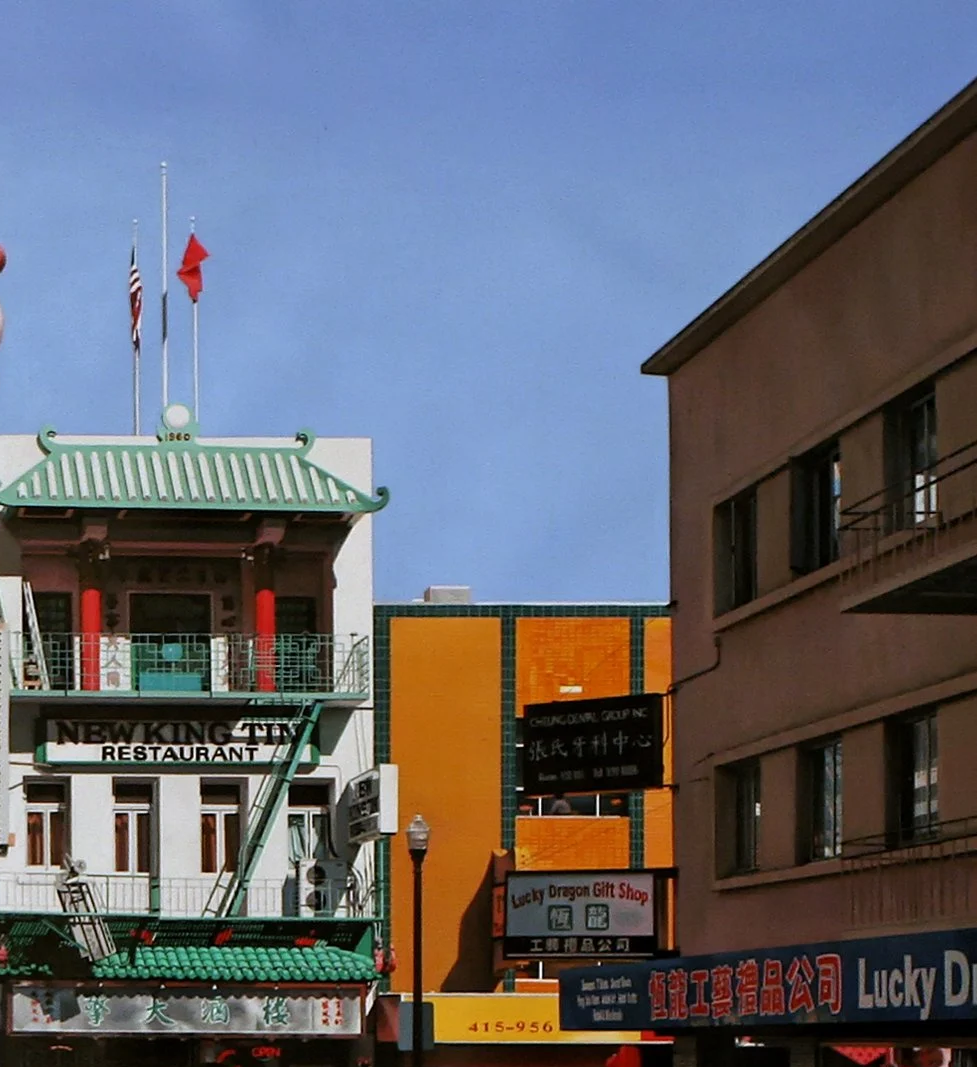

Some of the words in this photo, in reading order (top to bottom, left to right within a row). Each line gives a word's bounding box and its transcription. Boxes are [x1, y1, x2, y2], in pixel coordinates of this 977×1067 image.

[141, 721, 232, 746] KING
[100, 746, 259, 762] RESTAURANT
[511, 888, 545, 909] Lucky
[549, 884, 590, 901] Dragon
[593, 881, 615, 899] Gift
[619, 884, 649, 906] Shop
[858, 954, 937, 1020] Lucky
[469, 1021, 553, 1034] 415-956
